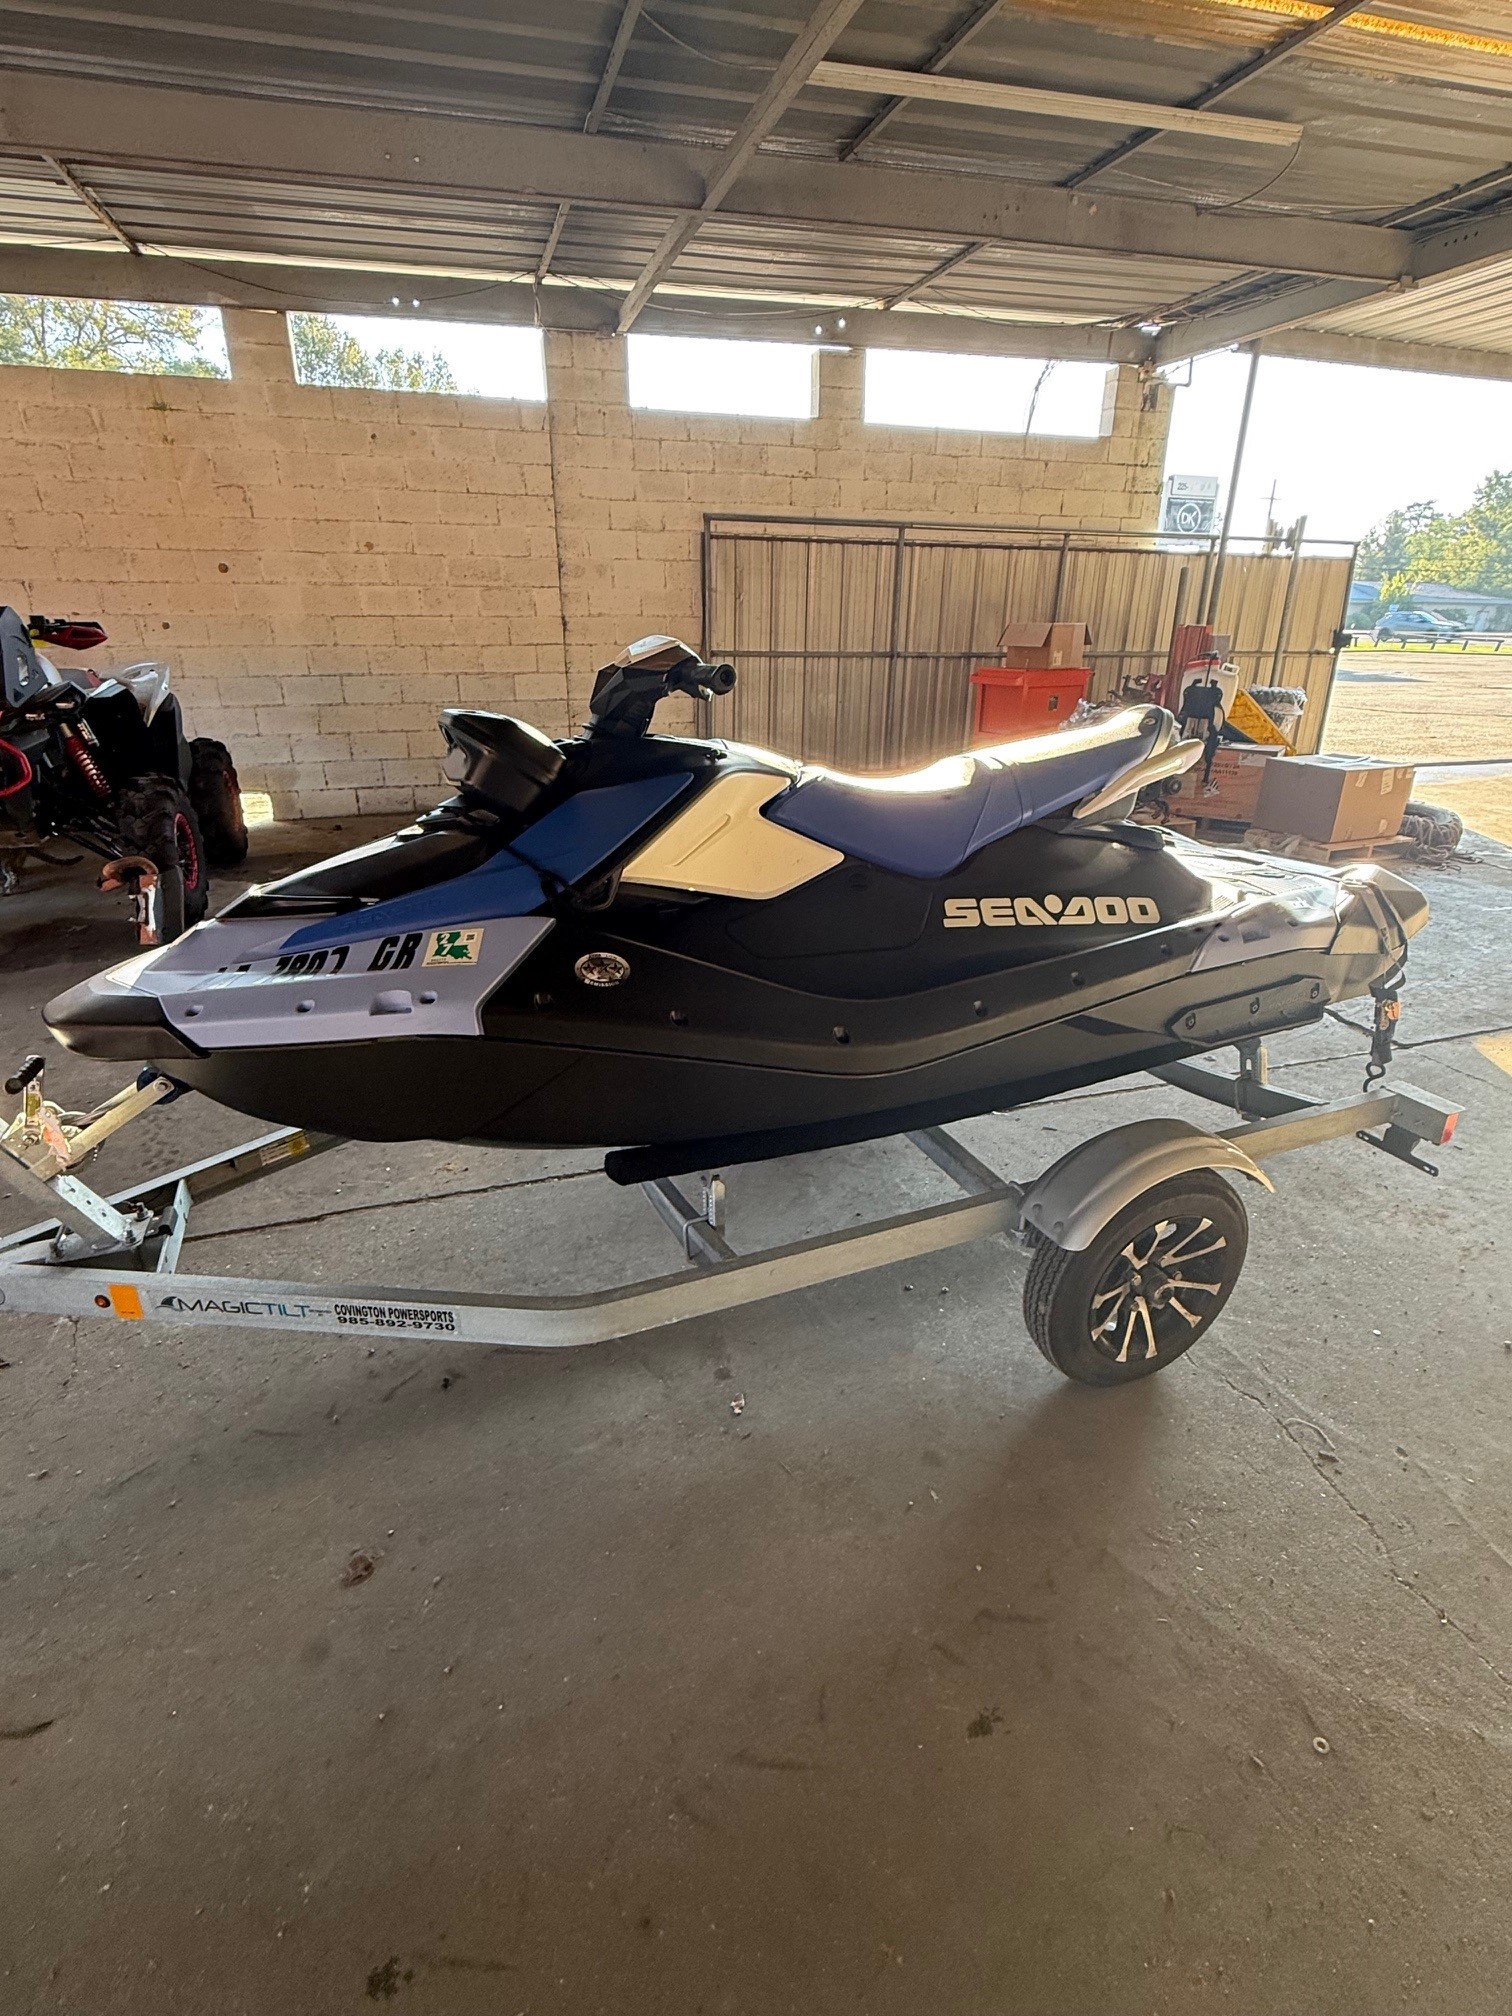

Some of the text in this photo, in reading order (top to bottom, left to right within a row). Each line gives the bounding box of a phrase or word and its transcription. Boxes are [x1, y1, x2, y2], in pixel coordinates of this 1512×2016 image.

[1181, 511, 1198, 527] DK
[439, 932, 451, 945] 2
[366, 931, 424, 972] GR
[440, 942, 454, 956] 7
[177, 1296, 311, 1318] MAGICTILT
[334, 1303, 387, 1319] COVINGTON
[388, 1306, 455, 1323] POWERSPORTS
[337, 1316, 456, 1332] 985-892-9730
